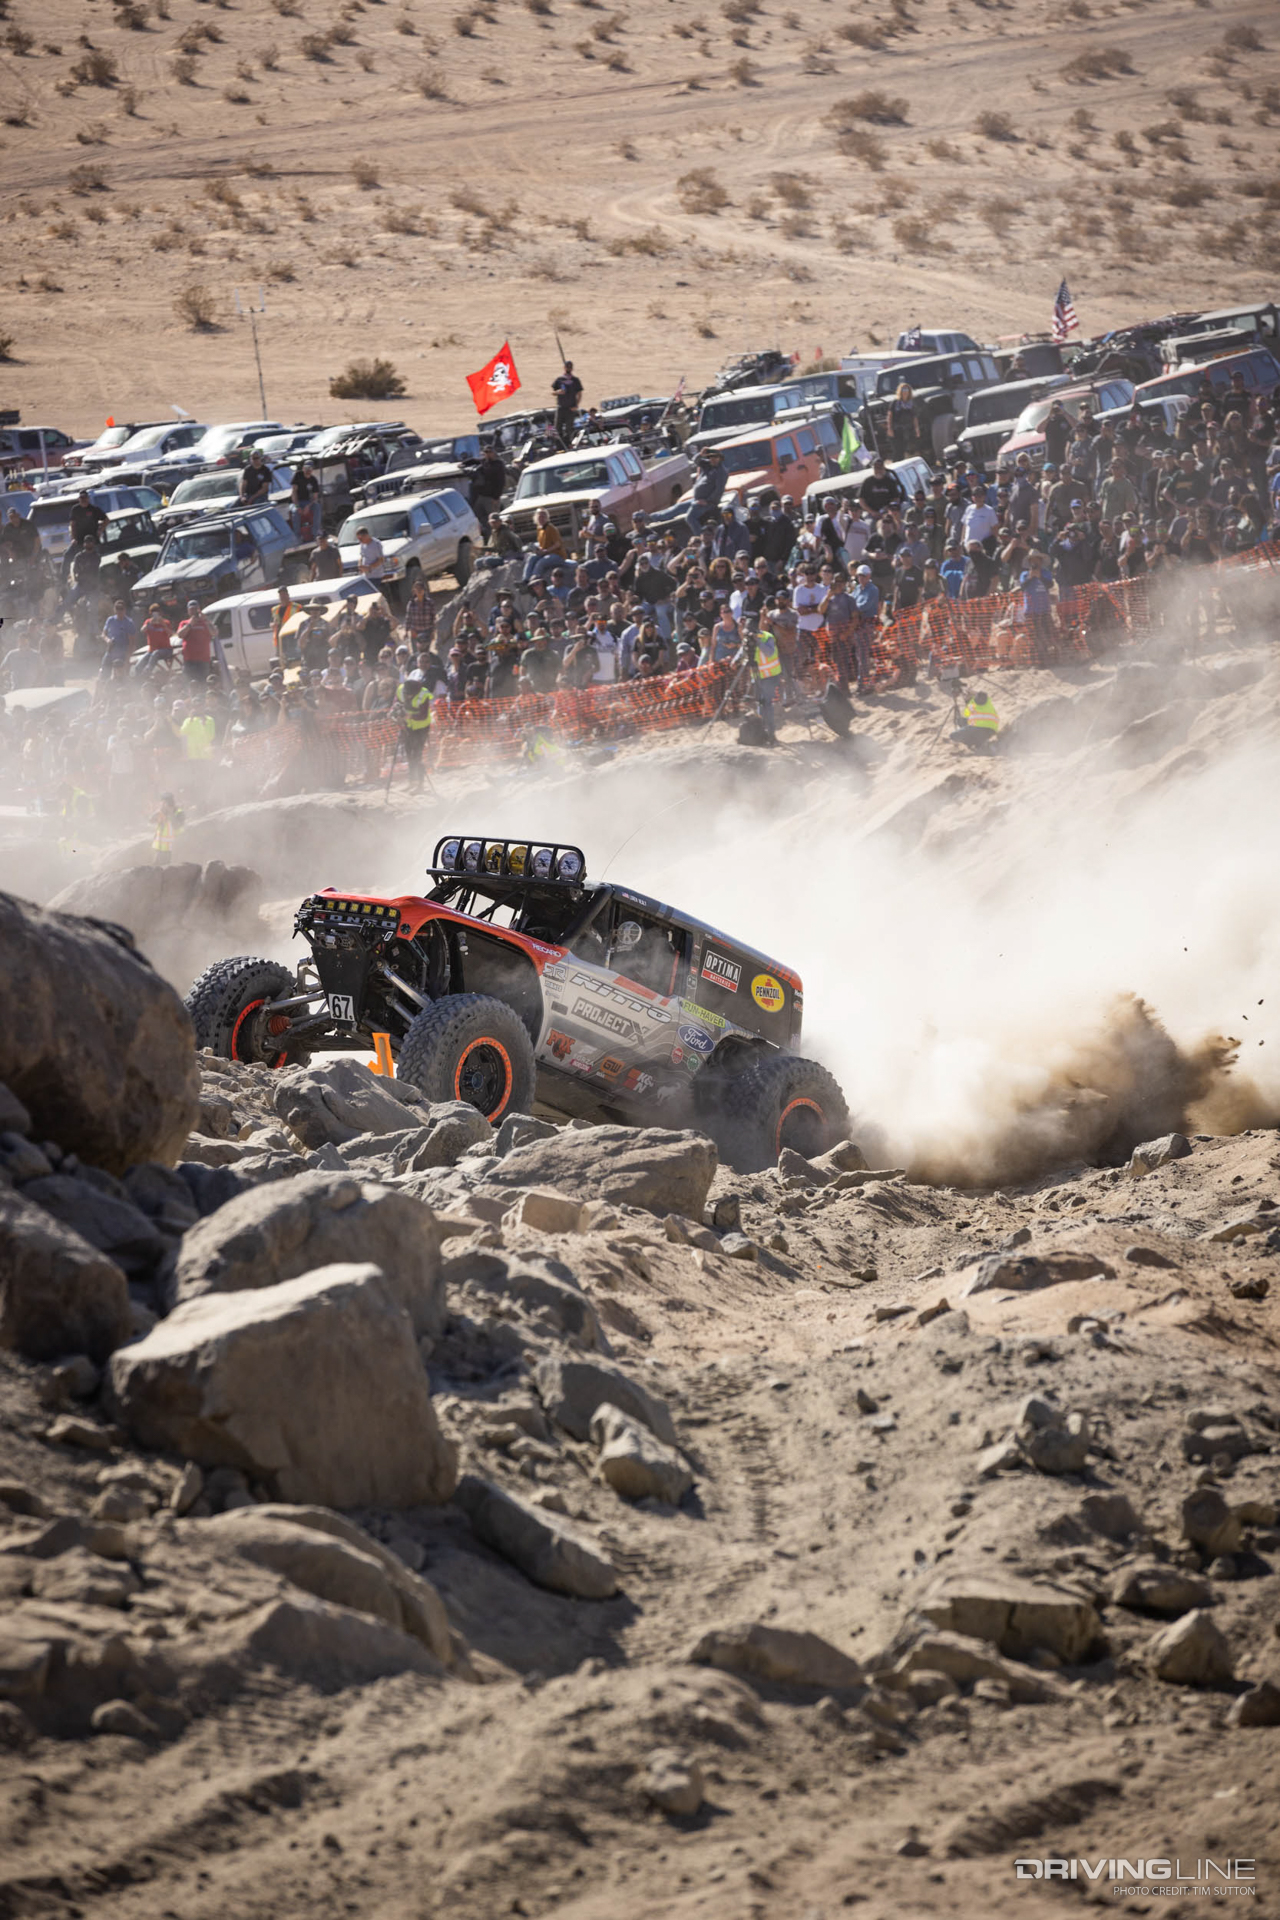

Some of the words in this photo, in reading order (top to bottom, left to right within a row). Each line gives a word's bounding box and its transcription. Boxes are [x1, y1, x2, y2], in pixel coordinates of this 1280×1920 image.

[705, 954, 739, 982] OPTIMA
[755, 986, 781, 1000] PENNZOIL
[332, 995, 351, 1019] 67
[573, 1000, 632, 1035] PROJECT
[683, 1002, 725, 1027] FUN-HAVER
[684, 1026, 709, 1050] Ford
